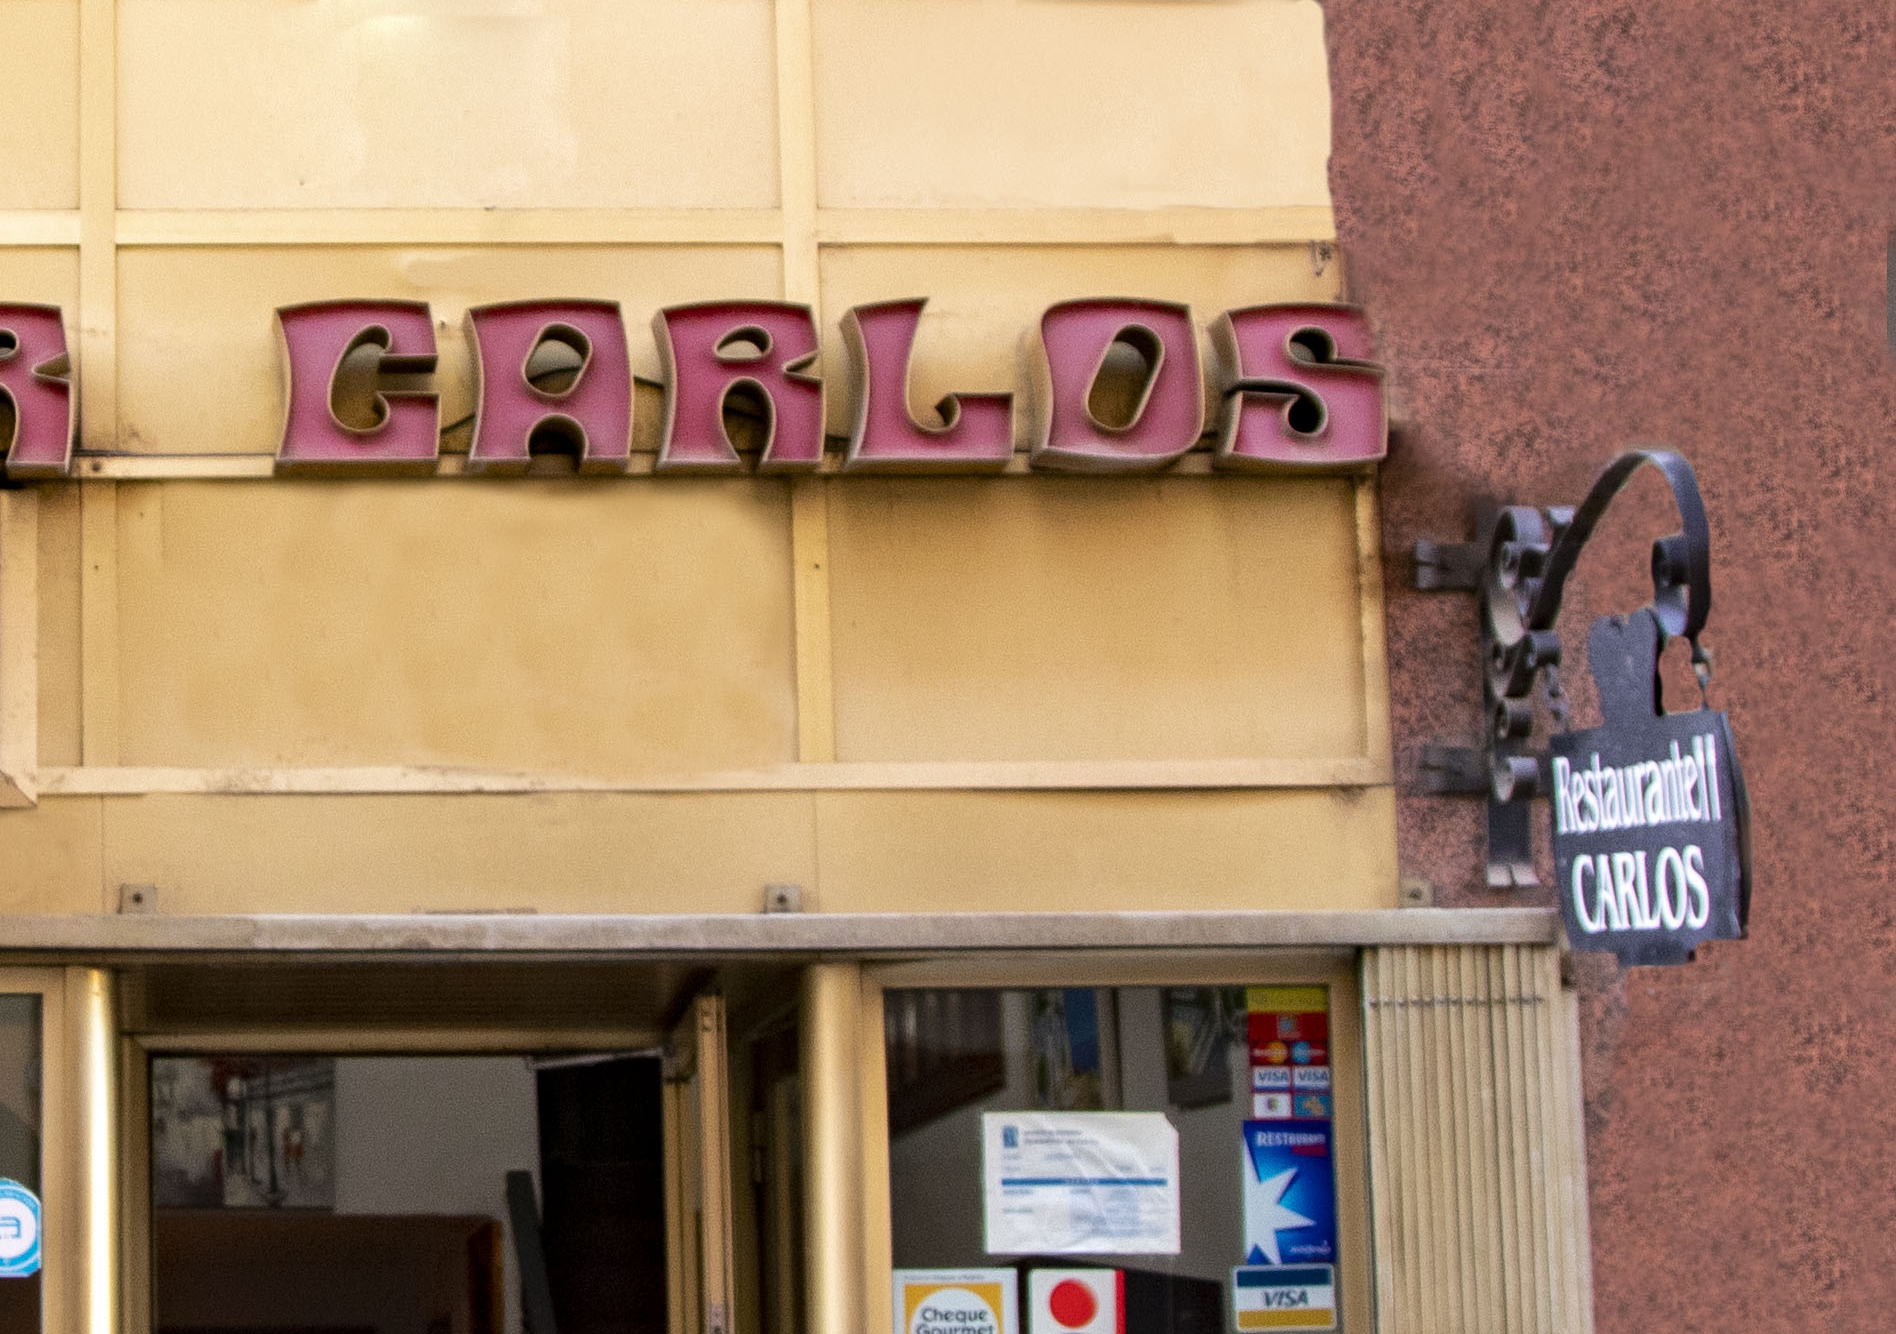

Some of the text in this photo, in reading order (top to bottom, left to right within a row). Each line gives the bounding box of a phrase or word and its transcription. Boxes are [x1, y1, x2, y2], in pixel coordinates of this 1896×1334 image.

[273, 296, 1393, 477] CARLOS
[1571, 844, 1711, 933] CARLOS
[1258, 1069, 1329, 1082] VISA VISA
[1263, 1289, 1309, 1307] VISA
[922, 1306, 988, 1325] Cheque
